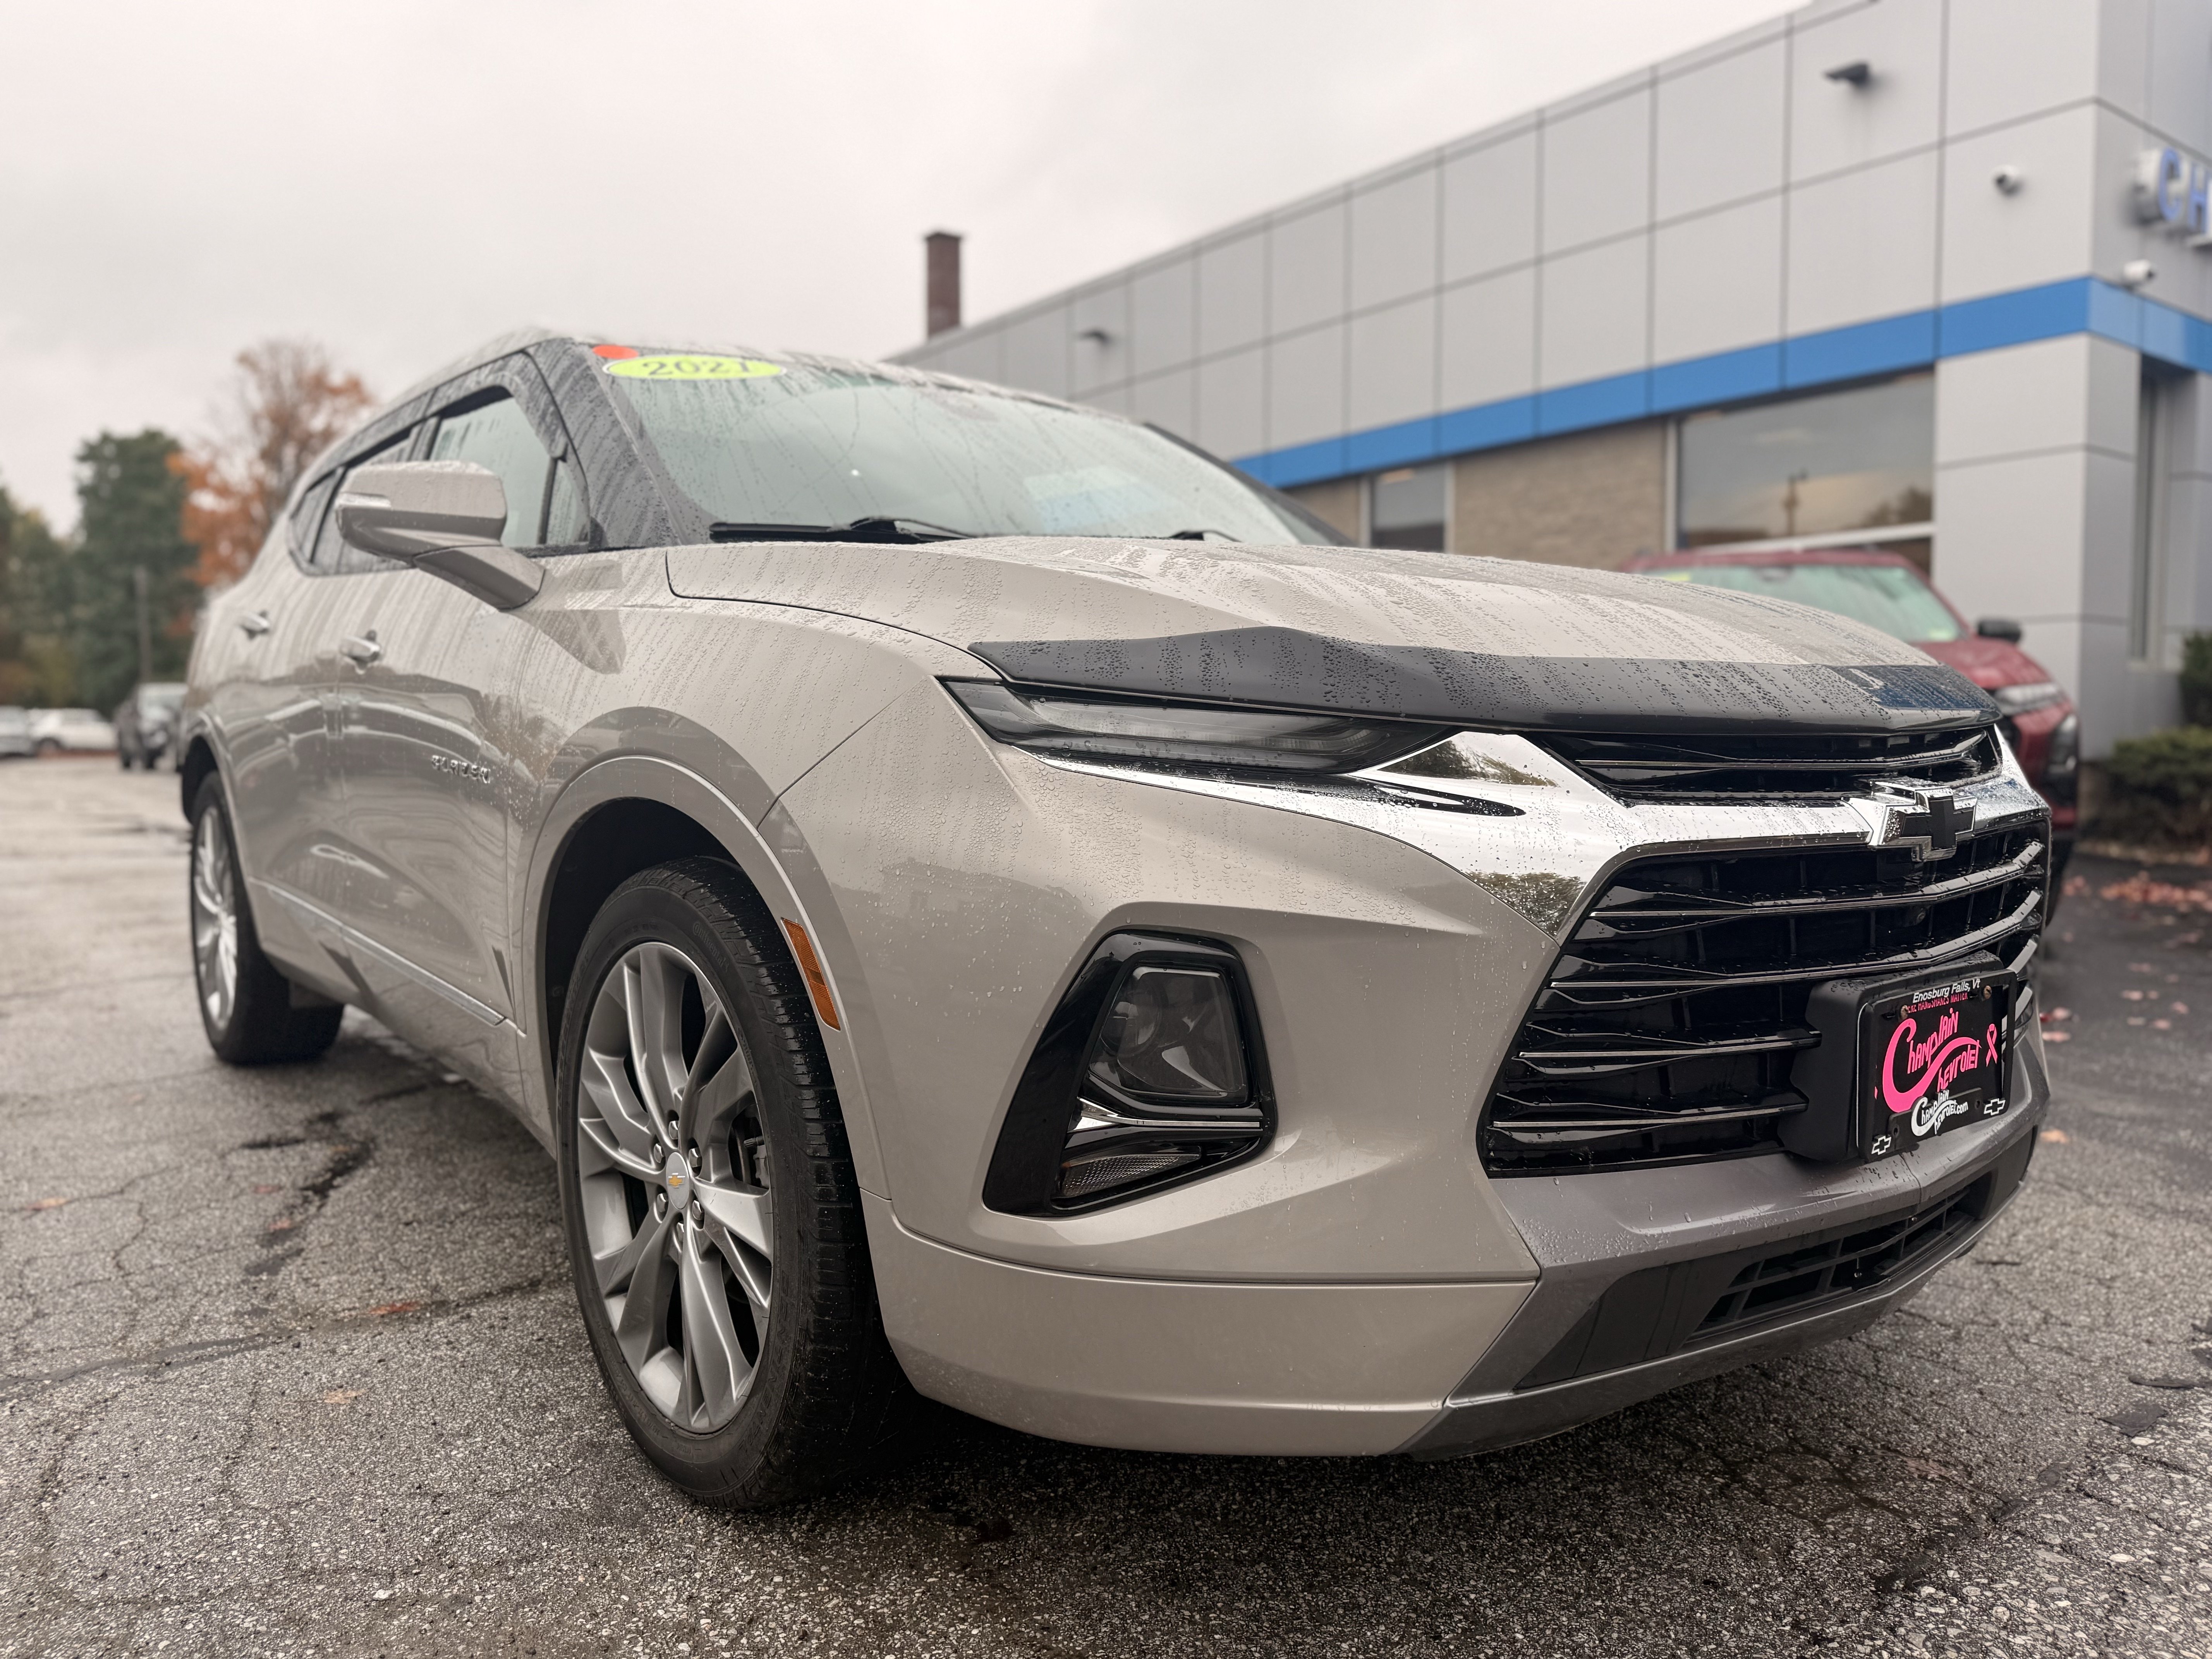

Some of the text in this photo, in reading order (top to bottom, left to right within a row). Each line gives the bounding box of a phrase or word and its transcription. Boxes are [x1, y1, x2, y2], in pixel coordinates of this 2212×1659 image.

[642, 360, 750, 375] 2021
[1912, 978, 1980, 1003] Enosburg Falls, Vt
